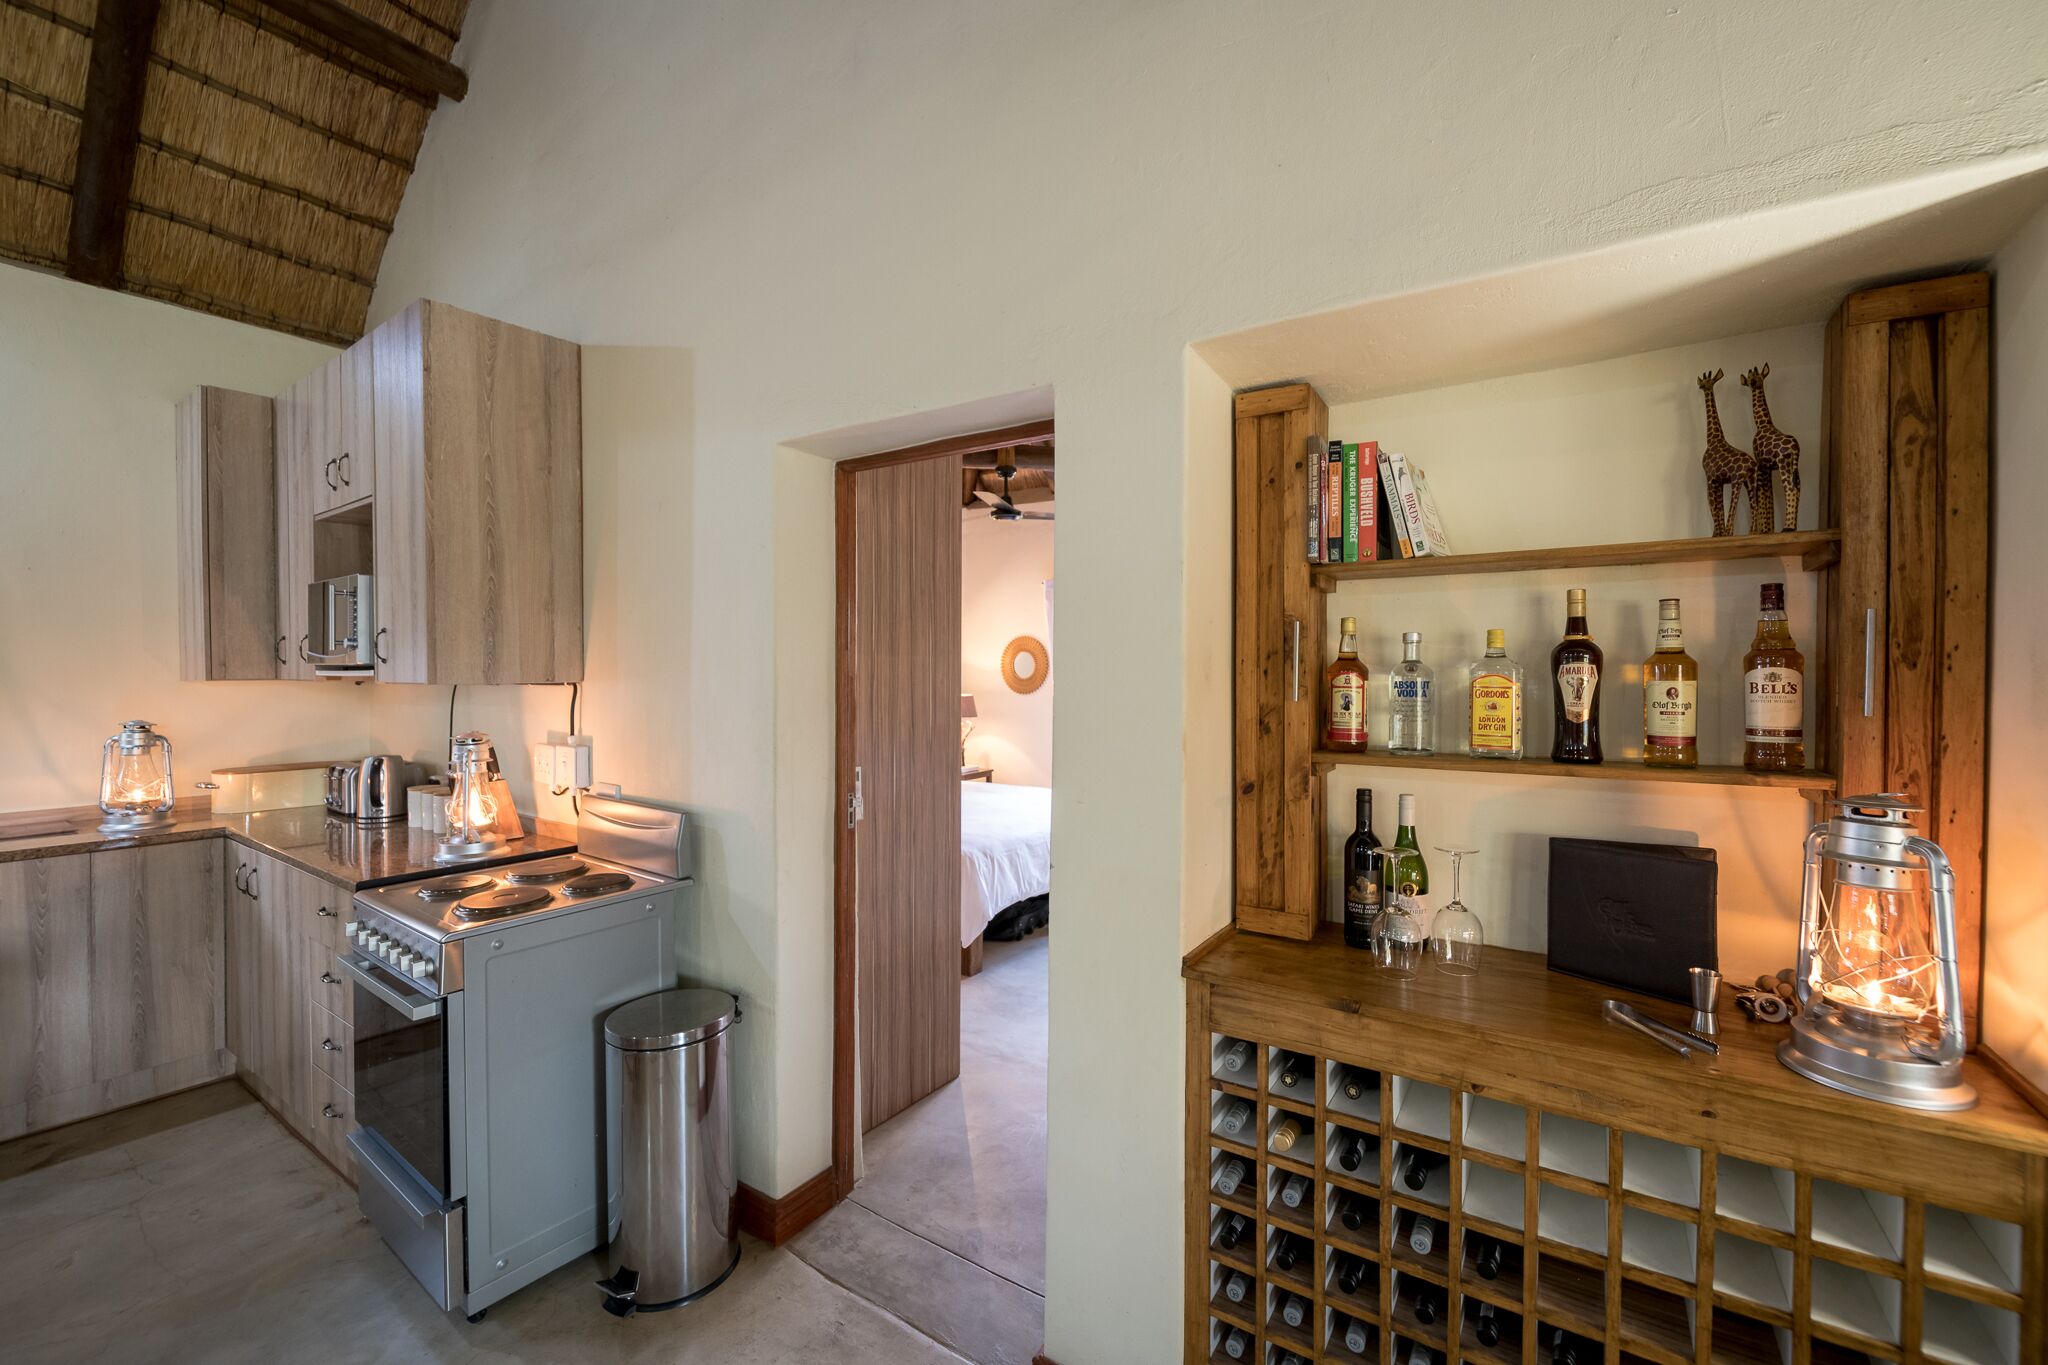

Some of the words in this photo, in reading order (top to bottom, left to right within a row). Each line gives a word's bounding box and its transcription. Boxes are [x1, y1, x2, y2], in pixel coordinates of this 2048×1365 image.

[1331, 475, 1339, 517] REPTILES
[1360, 477, 1374, 527] BUSHVELD
[1384, 471, 1401, 519] MAMMALS
[1405, 493, 1420, 525] BIRDS
[1349, 498, 1357, 543] EXPERIENCE
[1559, 664, 1597, 680] AMARULA
[1749, 681, 1798, 694] BELL'S
[1474, 688, 1510, 698] GORDON'S
[1478, 723, 1492, 731] DRY
[1493, 724, 1506, 732] GIN
